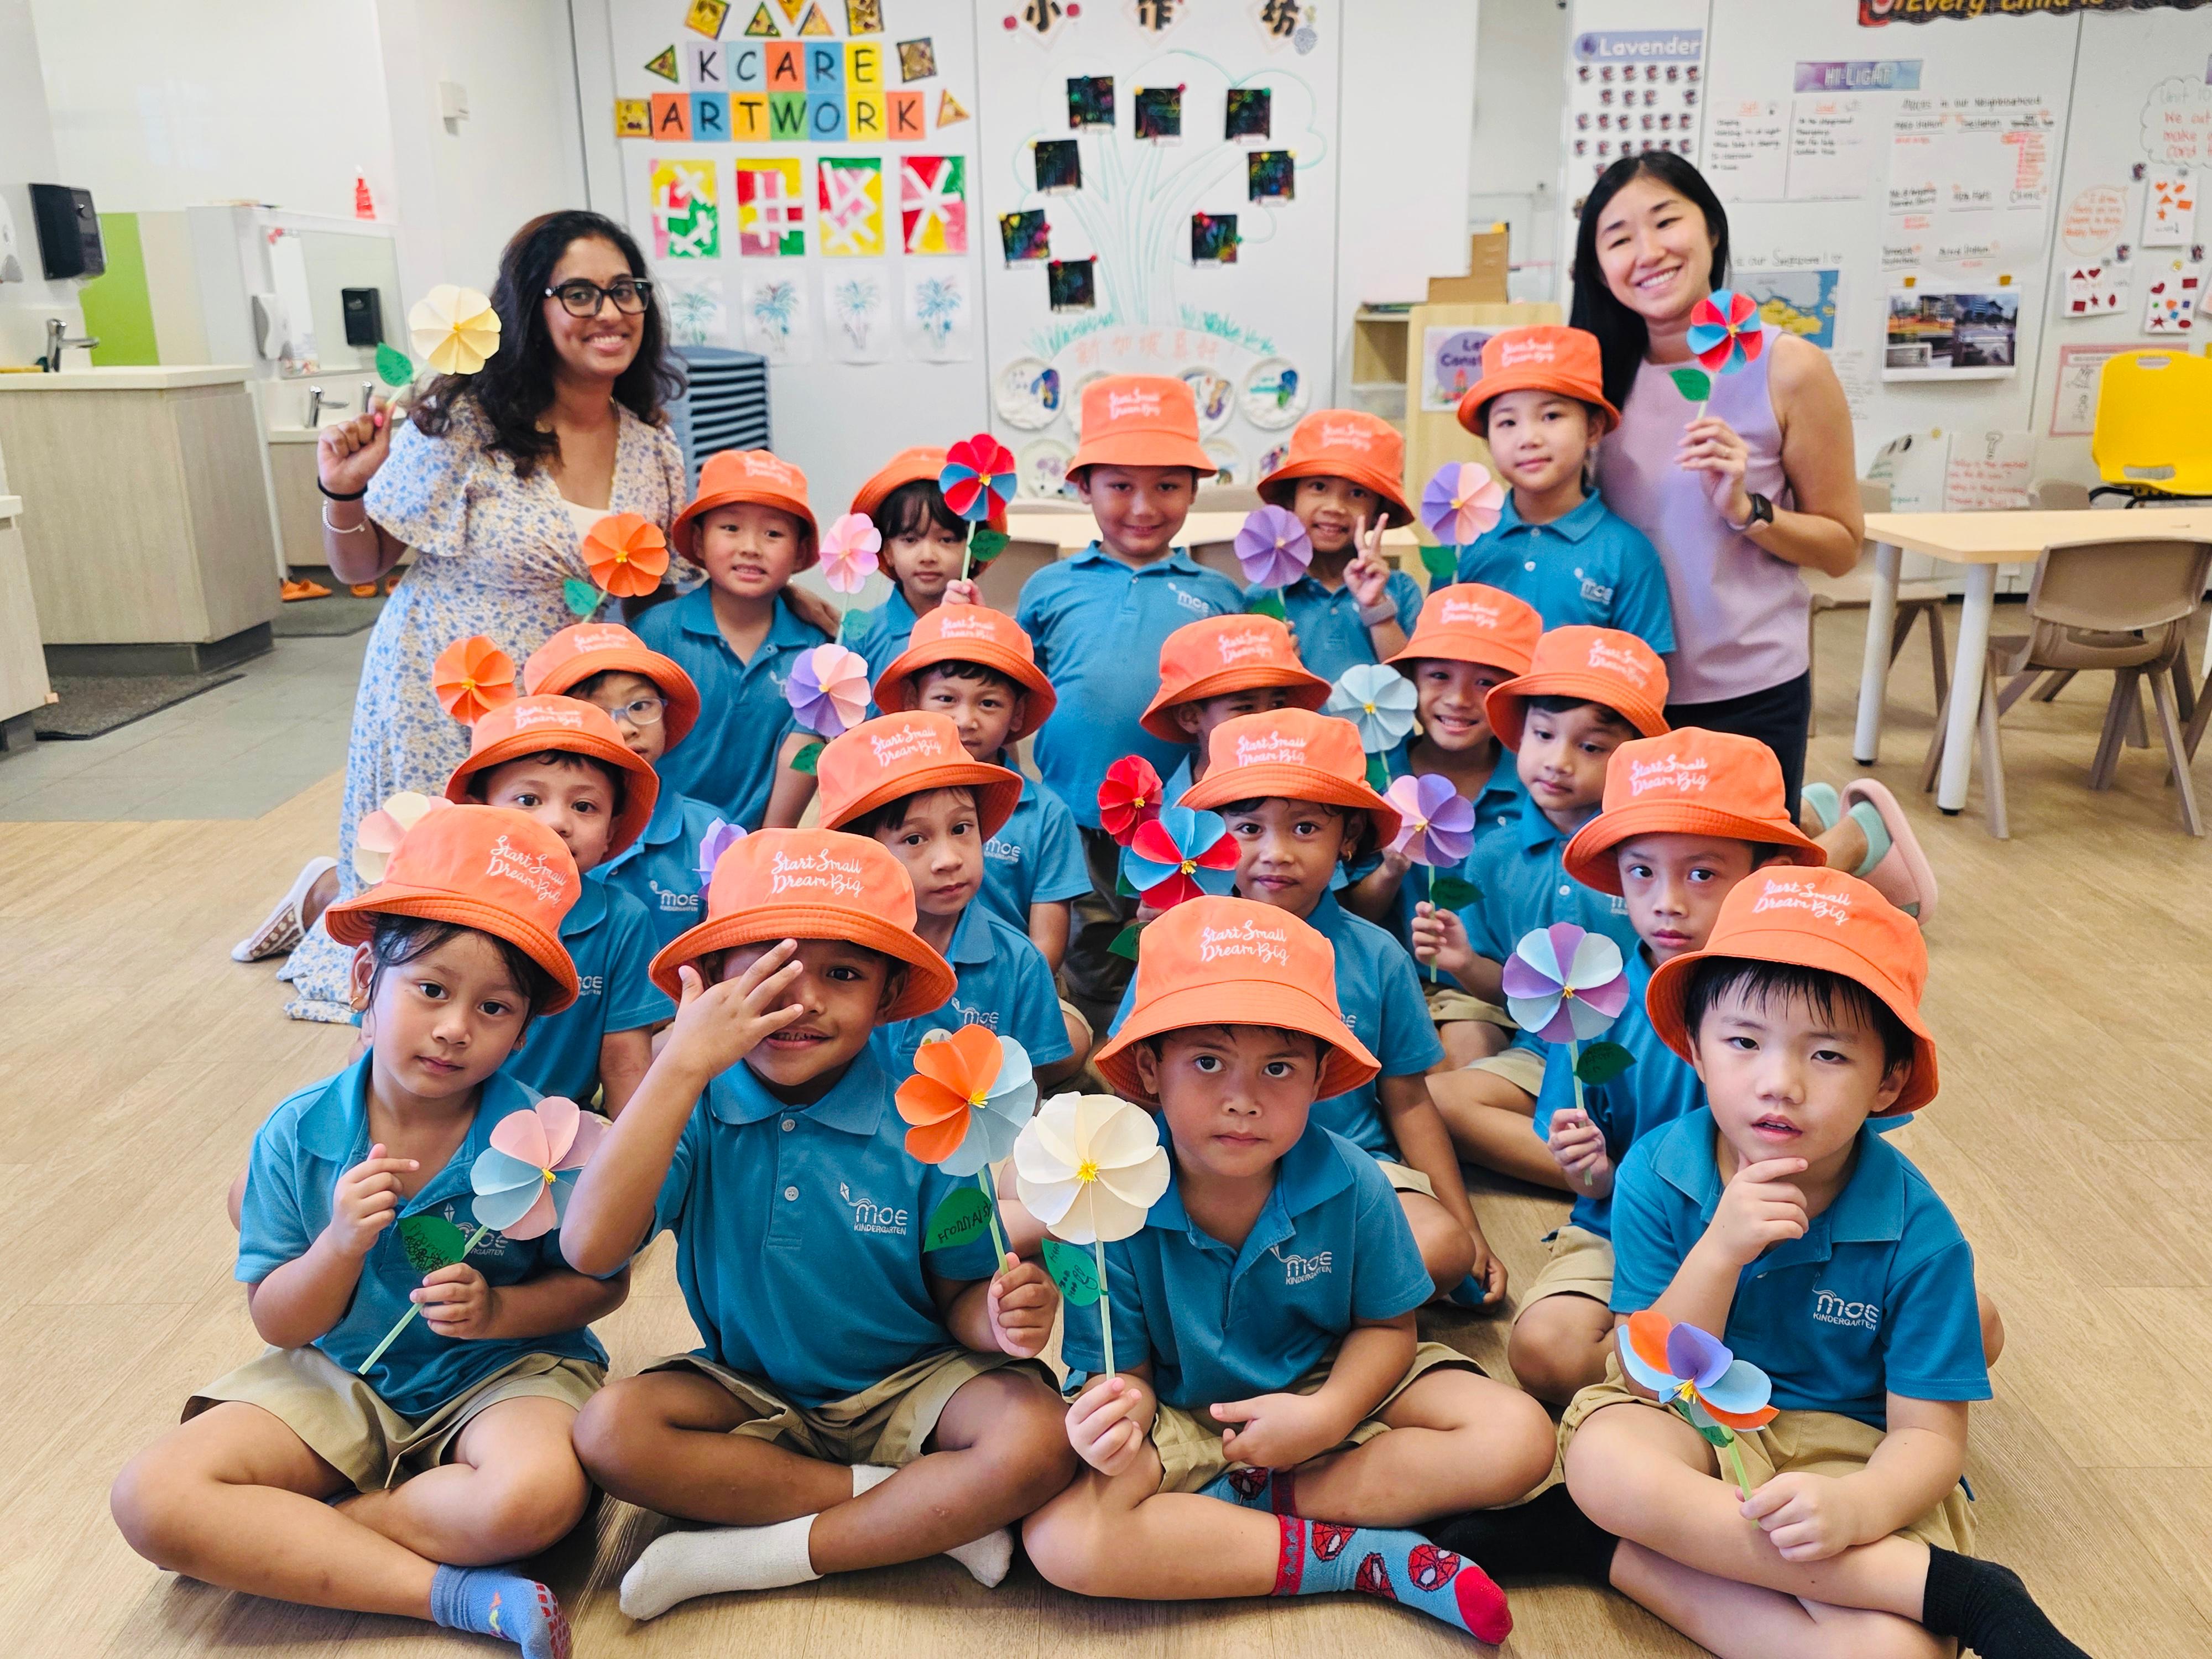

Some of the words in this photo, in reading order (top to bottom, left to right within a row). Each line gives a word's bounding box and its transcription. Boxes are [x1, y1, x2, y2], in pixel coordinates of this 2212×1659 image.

[1600, 36, 1700, 57] Lavender
[661, 101, 920, 134] ARTWORK
[870, 732, 905, 755] Start
[902, 724, 936, 743] Small
[877, 744, 919, 767] Dream
[917, 739, 942, 757] Big
[490, 834, 533, 868] Start
[529, 853, 567, 887] Small
[771, 851, 817, 875] Start
[816, 848, 863, 874] Small
[486, 855, 536, 889] Dream
[536, 878, 562, 908] Big
[771, 874, 831, 894] Dream
[830, 873, 865, 899] Big
[1761, 878, 1803, 898] Start
[1798, 882, 1852, 906] Small
[1751, 897, 1812, 914] Dream
[1811, 899, 1850, 926] Big
[1200, 926, 1243, 948] Start
[1241, 920, 1287, 942] Small
[1201, 944, 1257, 962] Dream
[1256, 941, 1291, 967] Big
[854, 1223, 907, 1236] KINDERGARTEN
[1286, 1266, 1332, 1285] KINDERGARTEN
[1813, 1312, 1876, 1332] KINDERGARTEN
